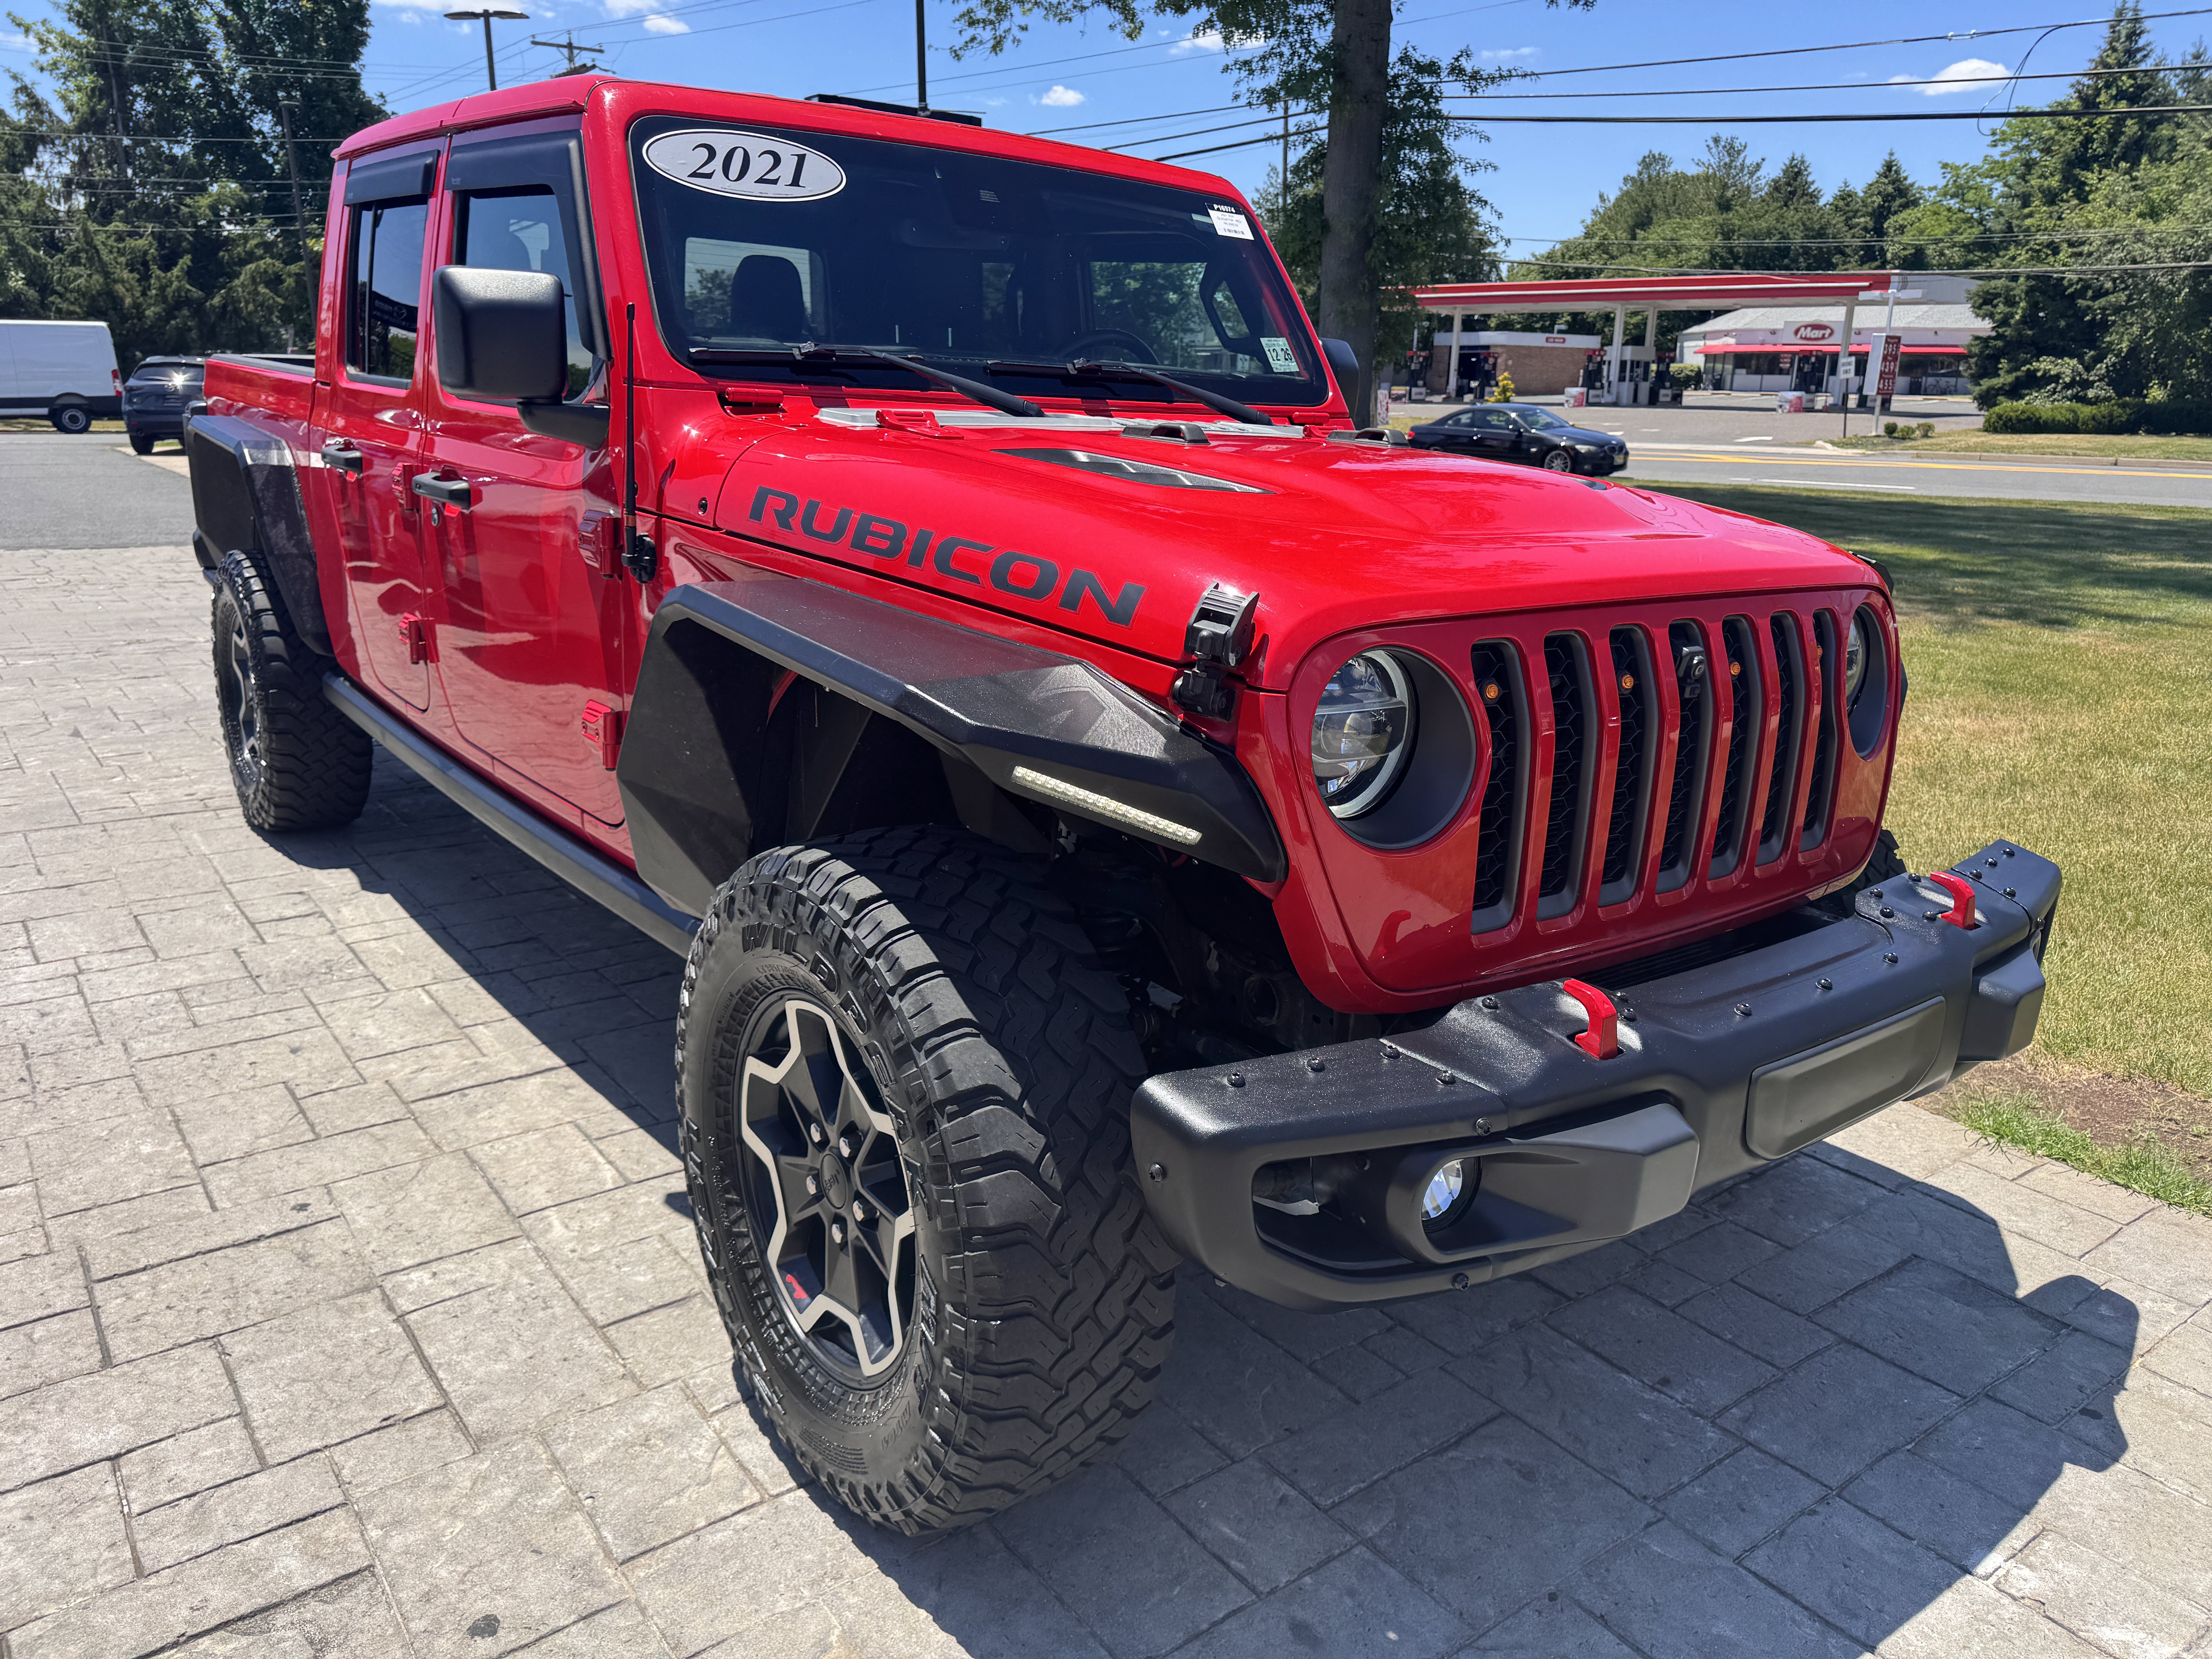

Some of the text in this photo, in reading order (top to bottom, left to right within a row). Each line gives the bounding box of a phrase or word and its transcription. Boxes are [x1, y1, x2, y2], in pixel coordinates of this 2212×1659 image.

[687, 143, 806, 188] 2021
[1796, 326, 1831, 339] Mart
[1268, 348, 1292, 361] 12 26
[748, 485, 1148, 629] RUBICON
[742, 925, 930, 1223] WILDPEAK
[824, 1169, 840, 1194] Jeep
